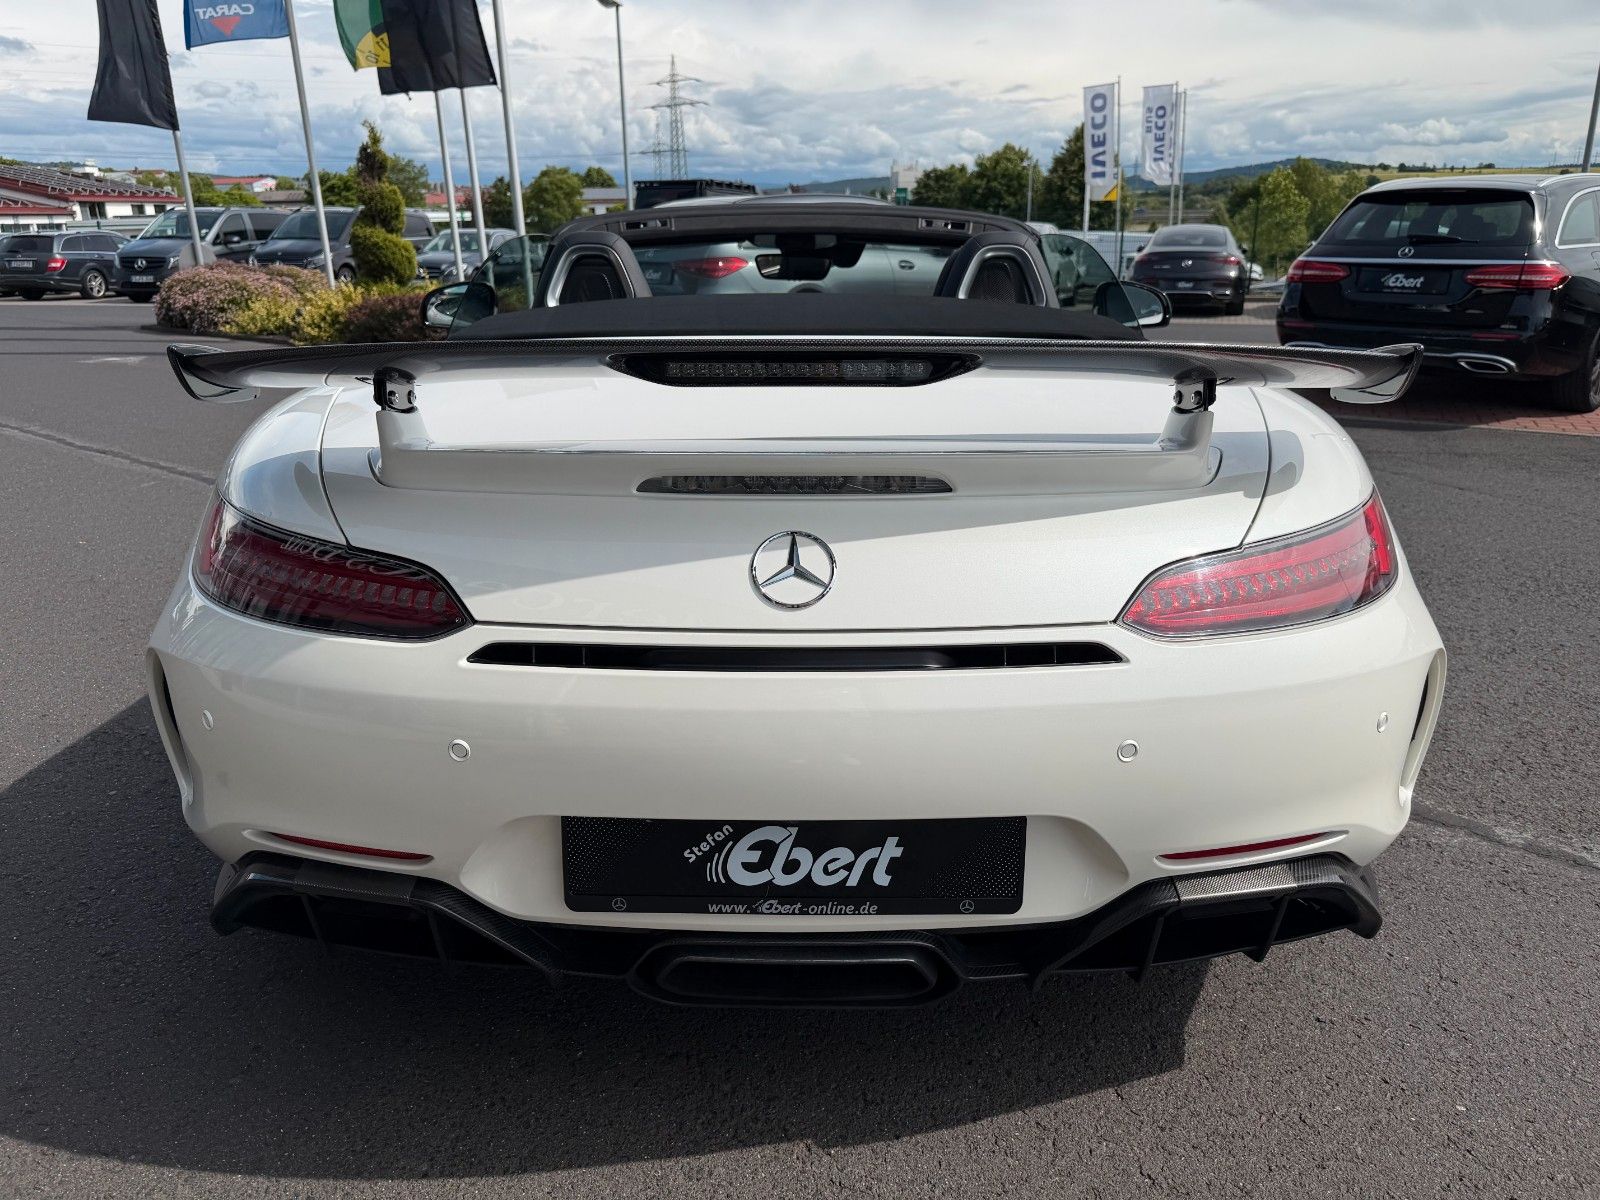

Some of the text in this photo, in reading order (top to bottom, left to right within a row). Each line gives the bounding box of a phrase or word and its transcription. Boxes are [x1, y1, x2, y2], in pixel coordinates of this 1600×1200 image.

[1389, 273, 1424, 288] Ebert
[683, 824, 734, 863] Stefan
[727, 825, 904, 887] Ebert
